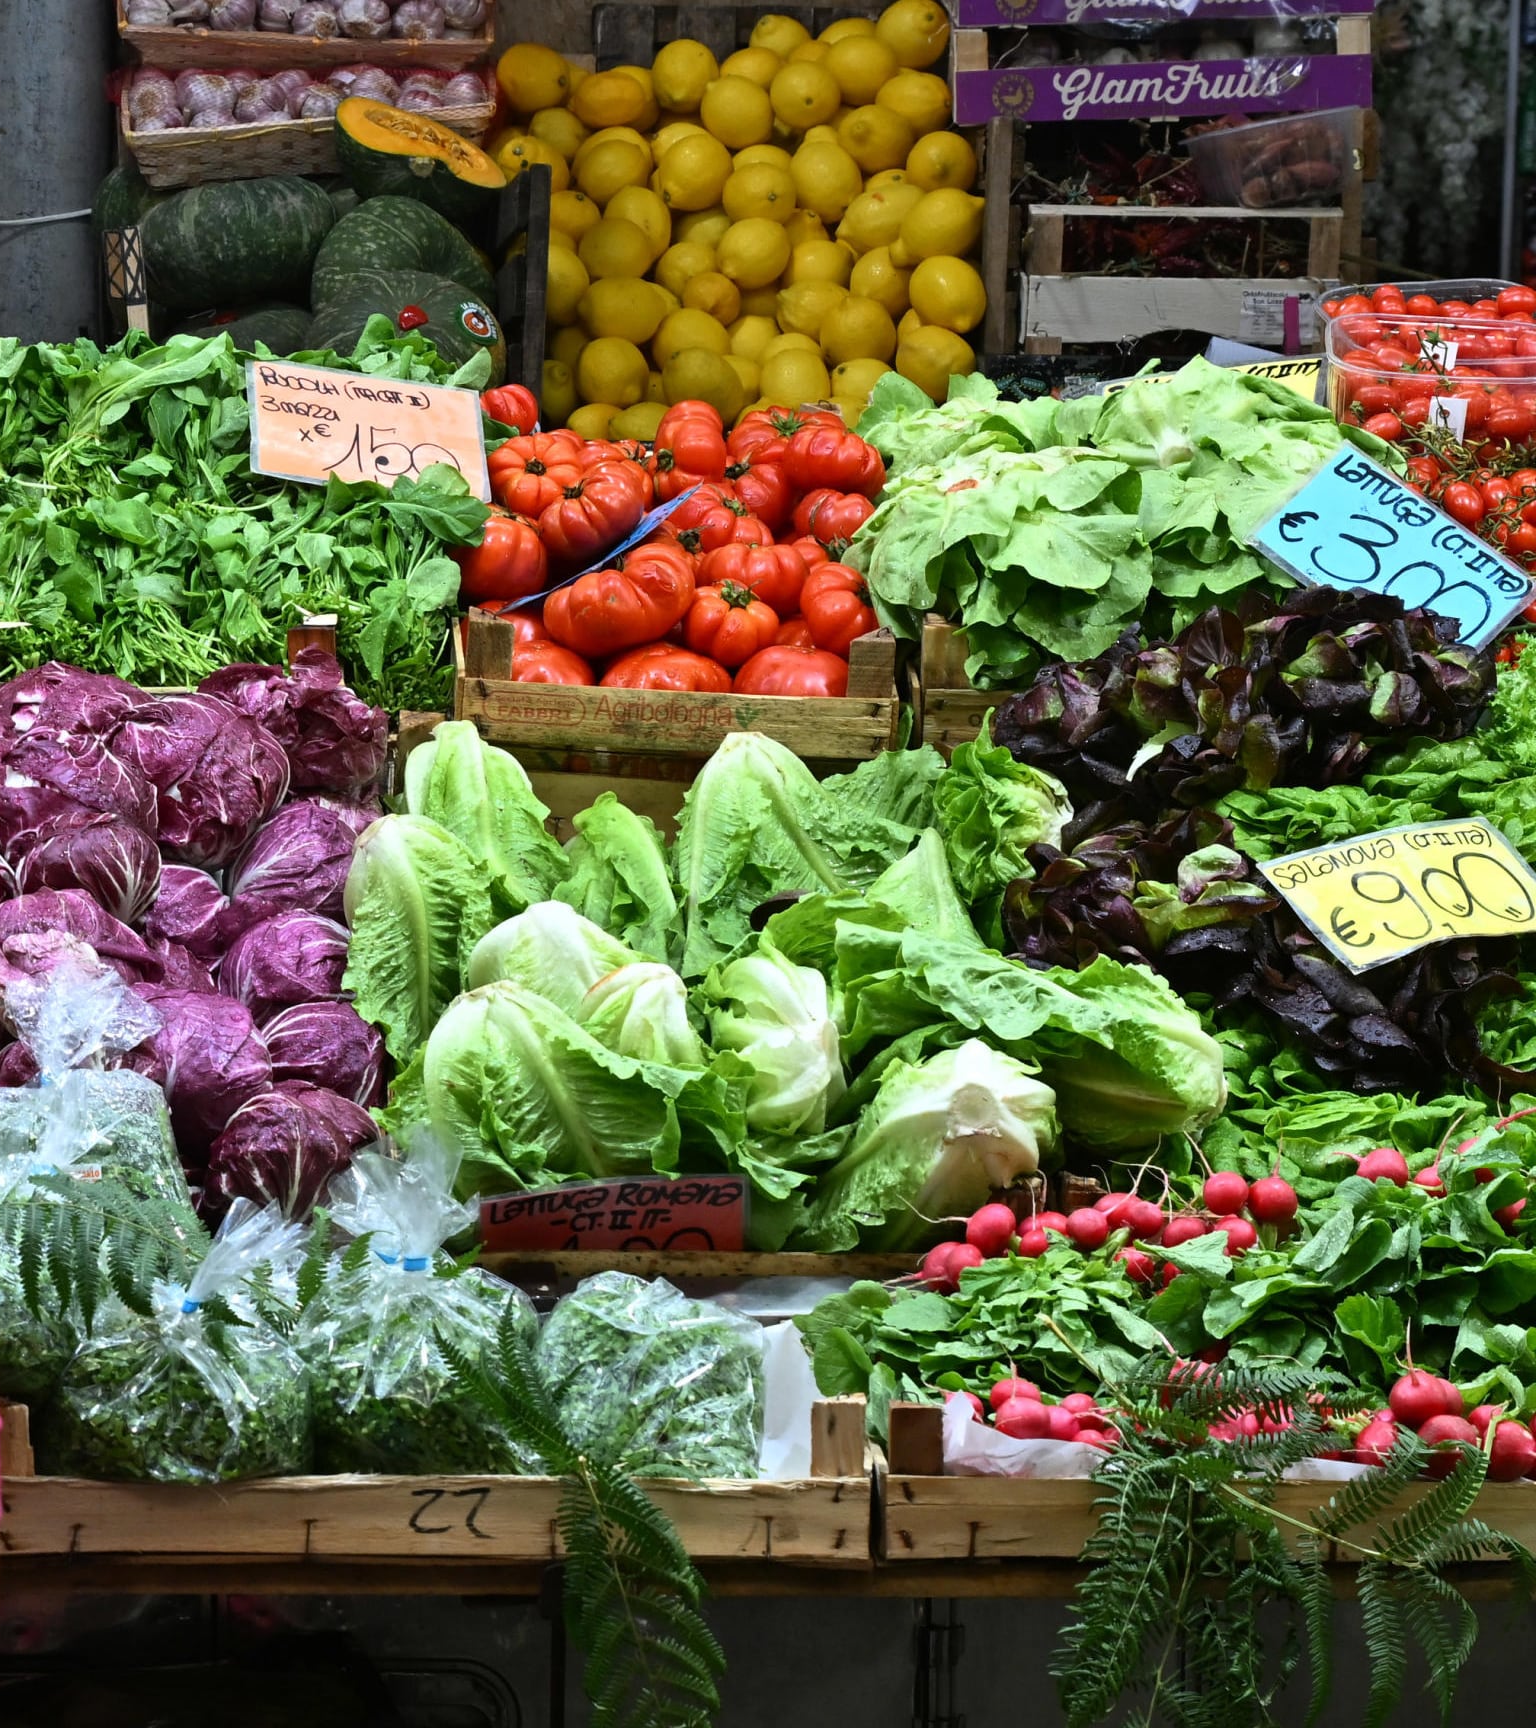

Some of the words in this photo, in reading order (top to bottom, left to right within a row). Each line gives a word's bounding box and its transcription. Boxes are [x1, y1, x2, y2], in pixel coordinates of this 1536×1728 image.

[1053, 63, 1278, 121] GlamFruits
[314, 423, 332, 438] €
[1279, 511, 1319, 542] €
[593, 694, 732, 731] Agribologna
[1331, 906, 1375, 948] €
